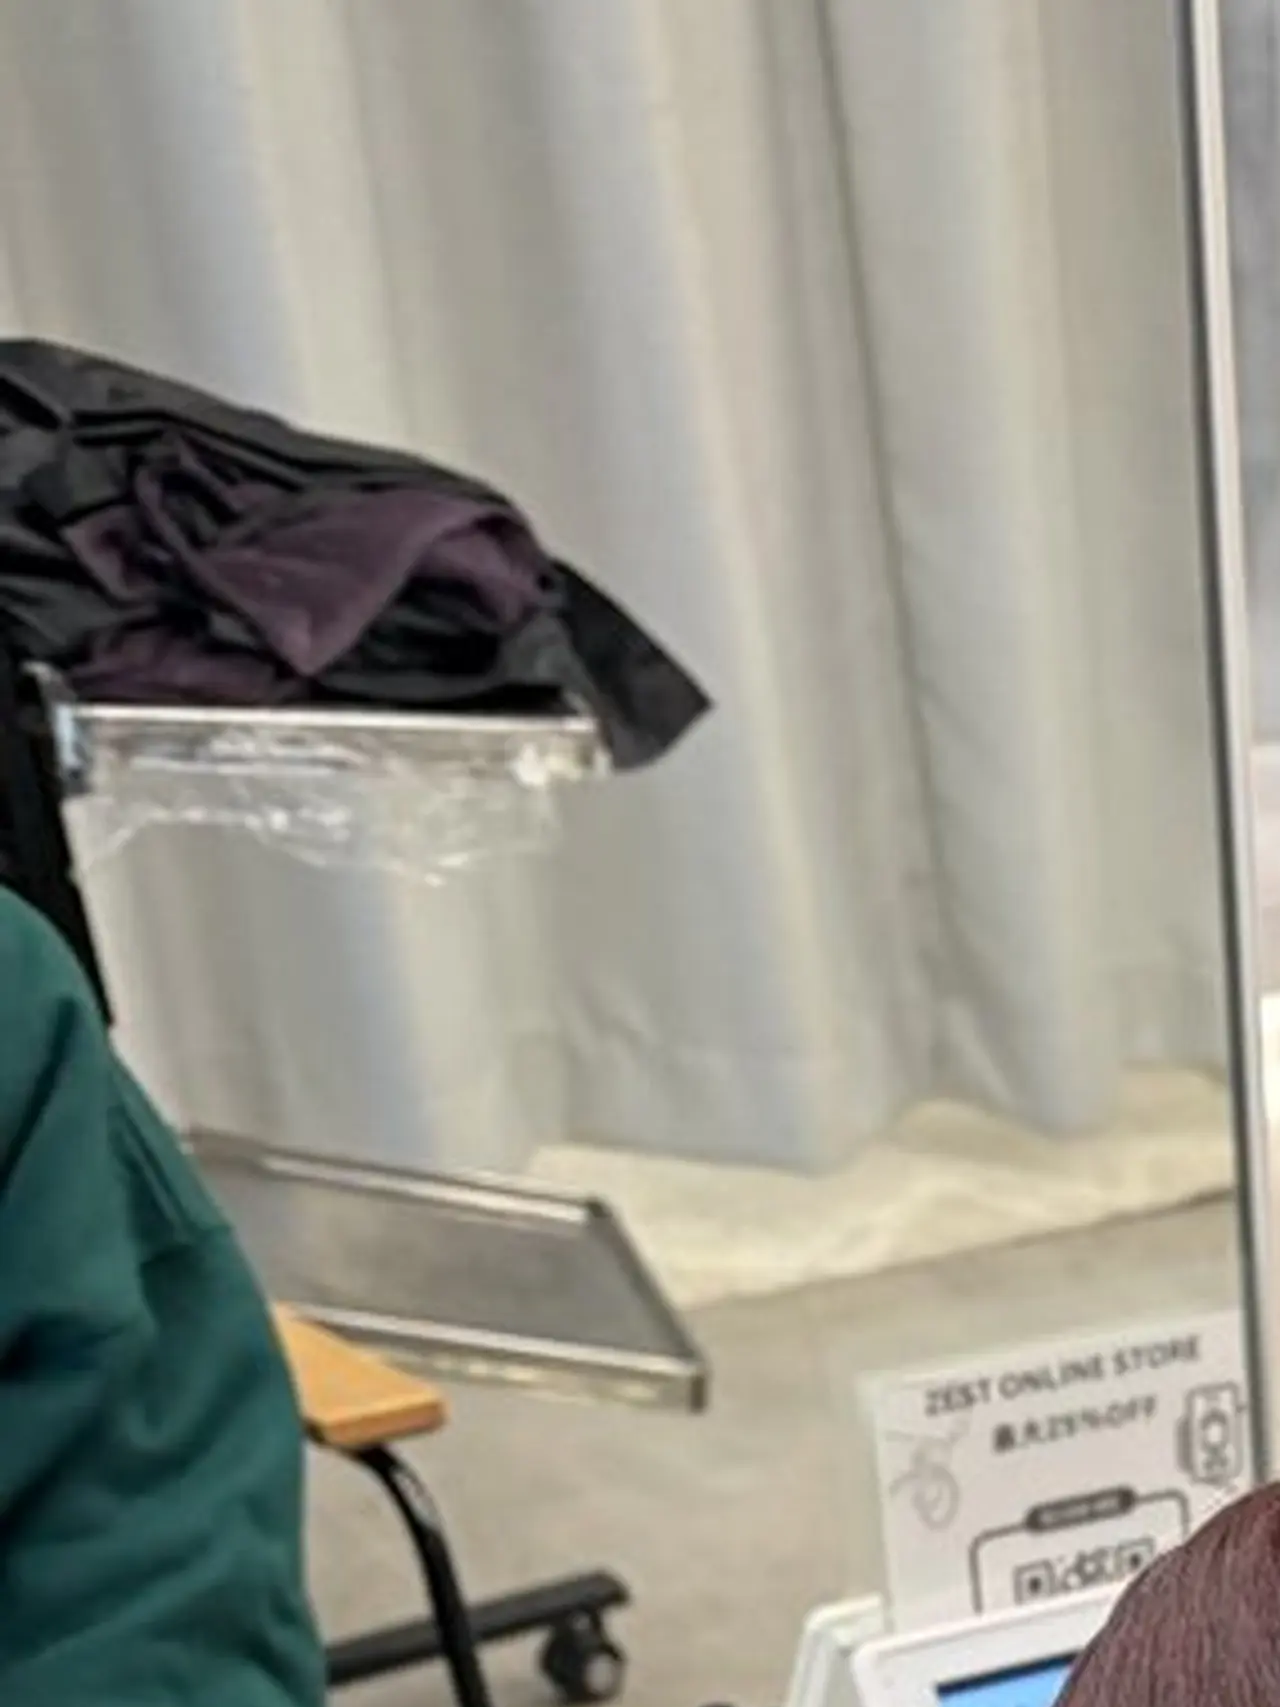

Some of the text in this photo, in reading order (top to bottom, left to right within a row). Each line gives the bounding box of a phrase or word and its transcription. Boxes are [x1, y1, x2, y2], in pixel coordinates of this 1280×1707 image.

[924, 1335, 1200, 1417] ZEST ONLINE STORE
